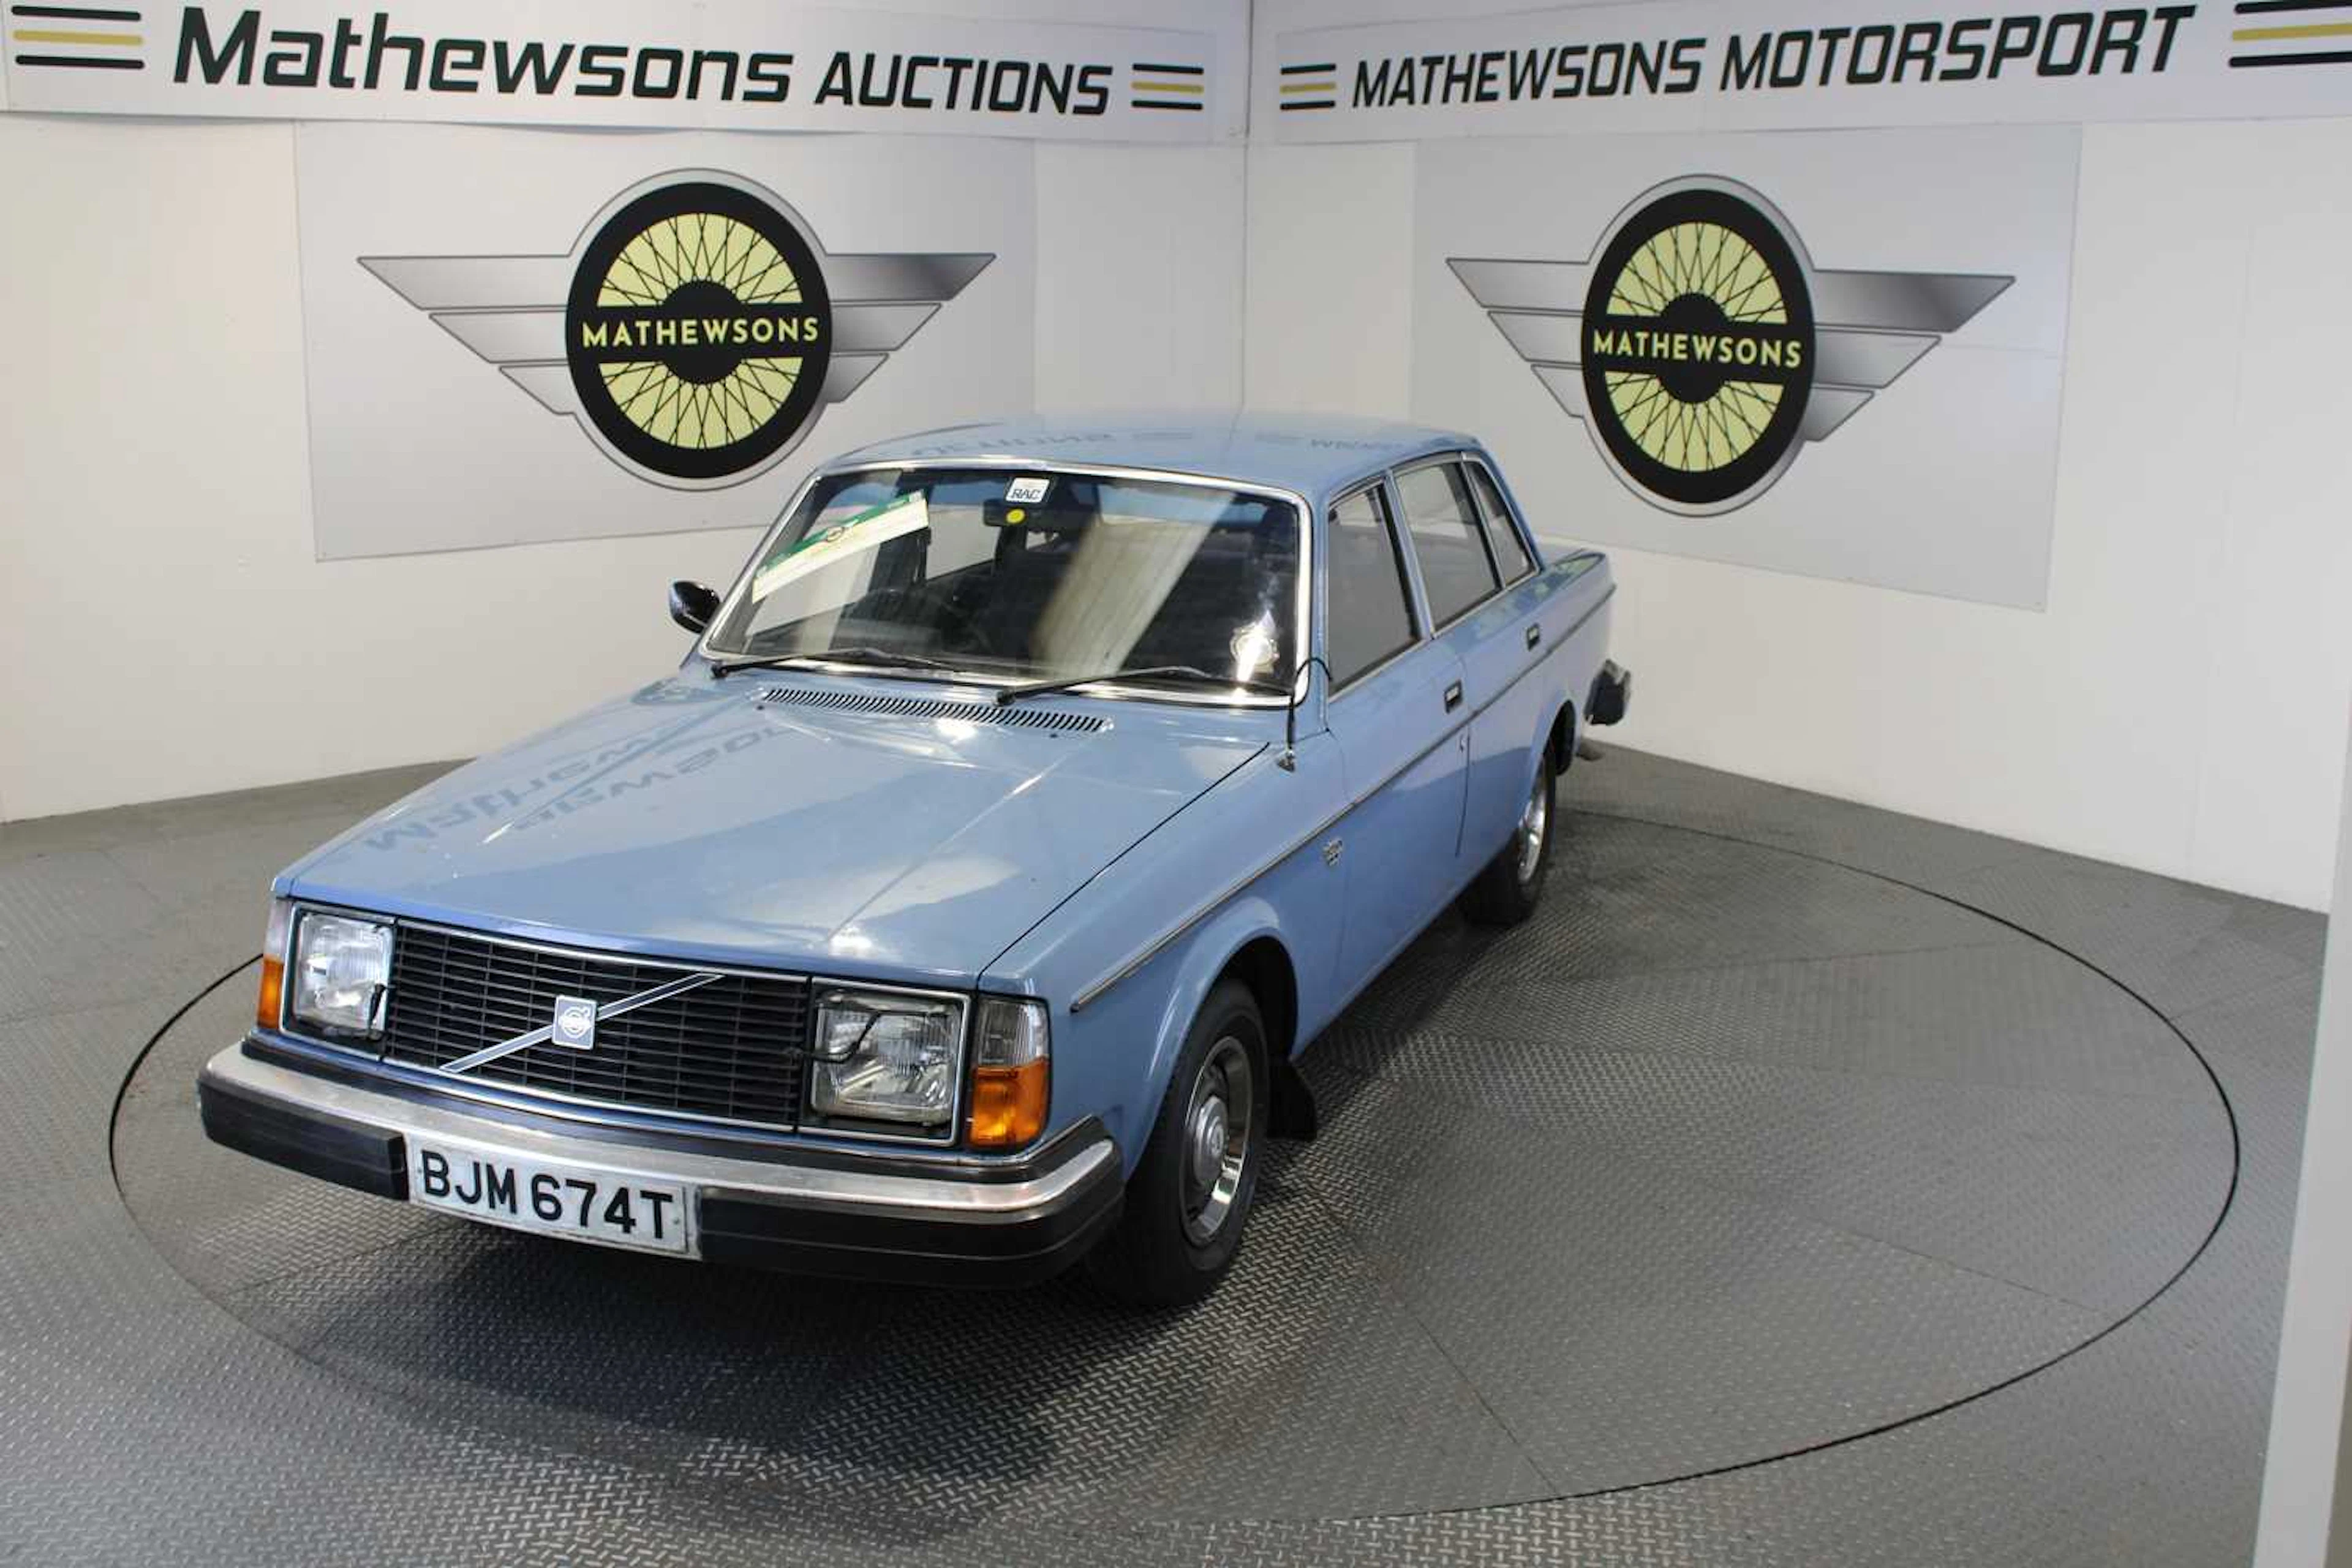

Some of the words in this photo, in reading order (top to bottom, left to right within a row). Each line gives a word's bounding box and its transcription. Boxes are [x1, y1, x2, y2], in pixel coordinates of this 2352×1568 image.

[174, 7, 793, 102] Mathewsons
[815, 52, 1113, 115] AUCTIONS
[1352, 38, 1706, 108] MATHEWSONS
[1720, 5, 2196, 91] MOTORSPORT
[582, 317, 818, 347] MATHEWSONS
[1594, 330, 1801, 368] MATHEWSONS
[1011, 489, 1041, 500] RAC
[421, 1150, 517, 1214] BJM
[530, 1174, 673, 1239] 674T
